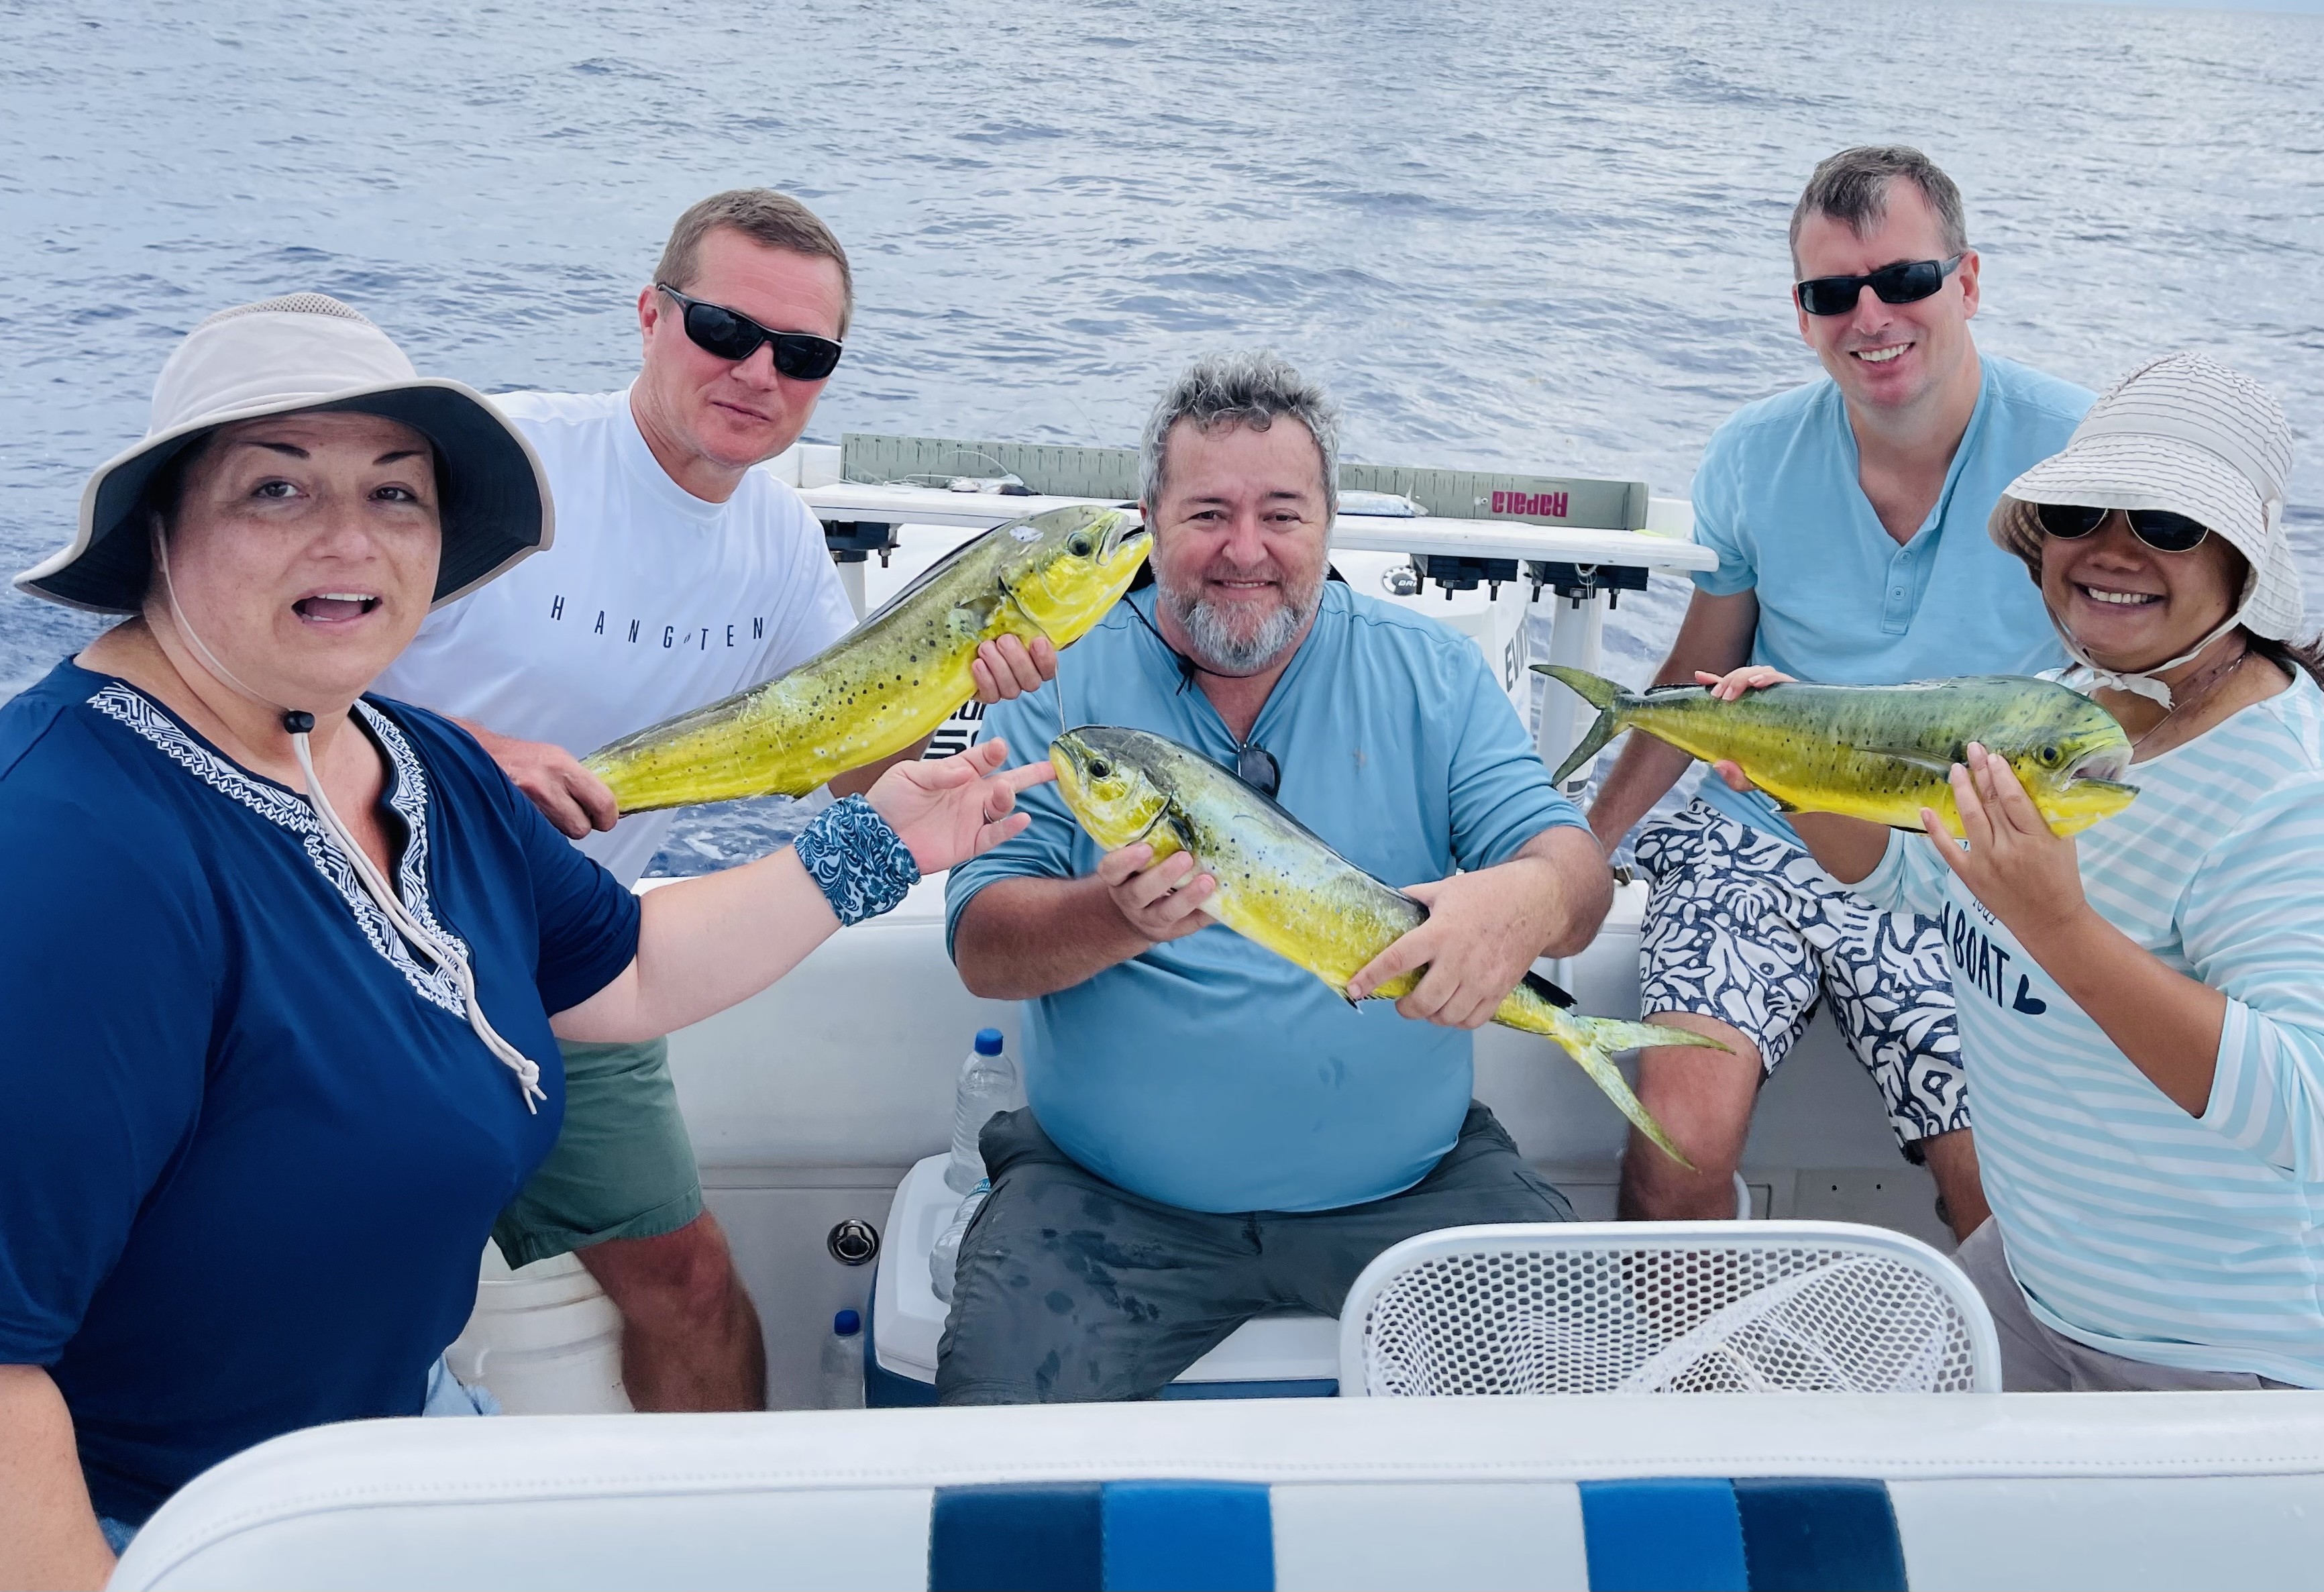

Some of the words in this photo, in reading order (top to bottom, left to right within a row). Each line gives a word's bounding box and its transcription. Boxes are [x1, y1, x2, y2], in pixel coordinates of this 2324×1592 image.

[1491, 490, 1568, 517] Rapala
[550, 595, 674, 649] HANG
[700, 617, 763, 650] TEN
[1953, 908, 2011, 1008] BOAT
